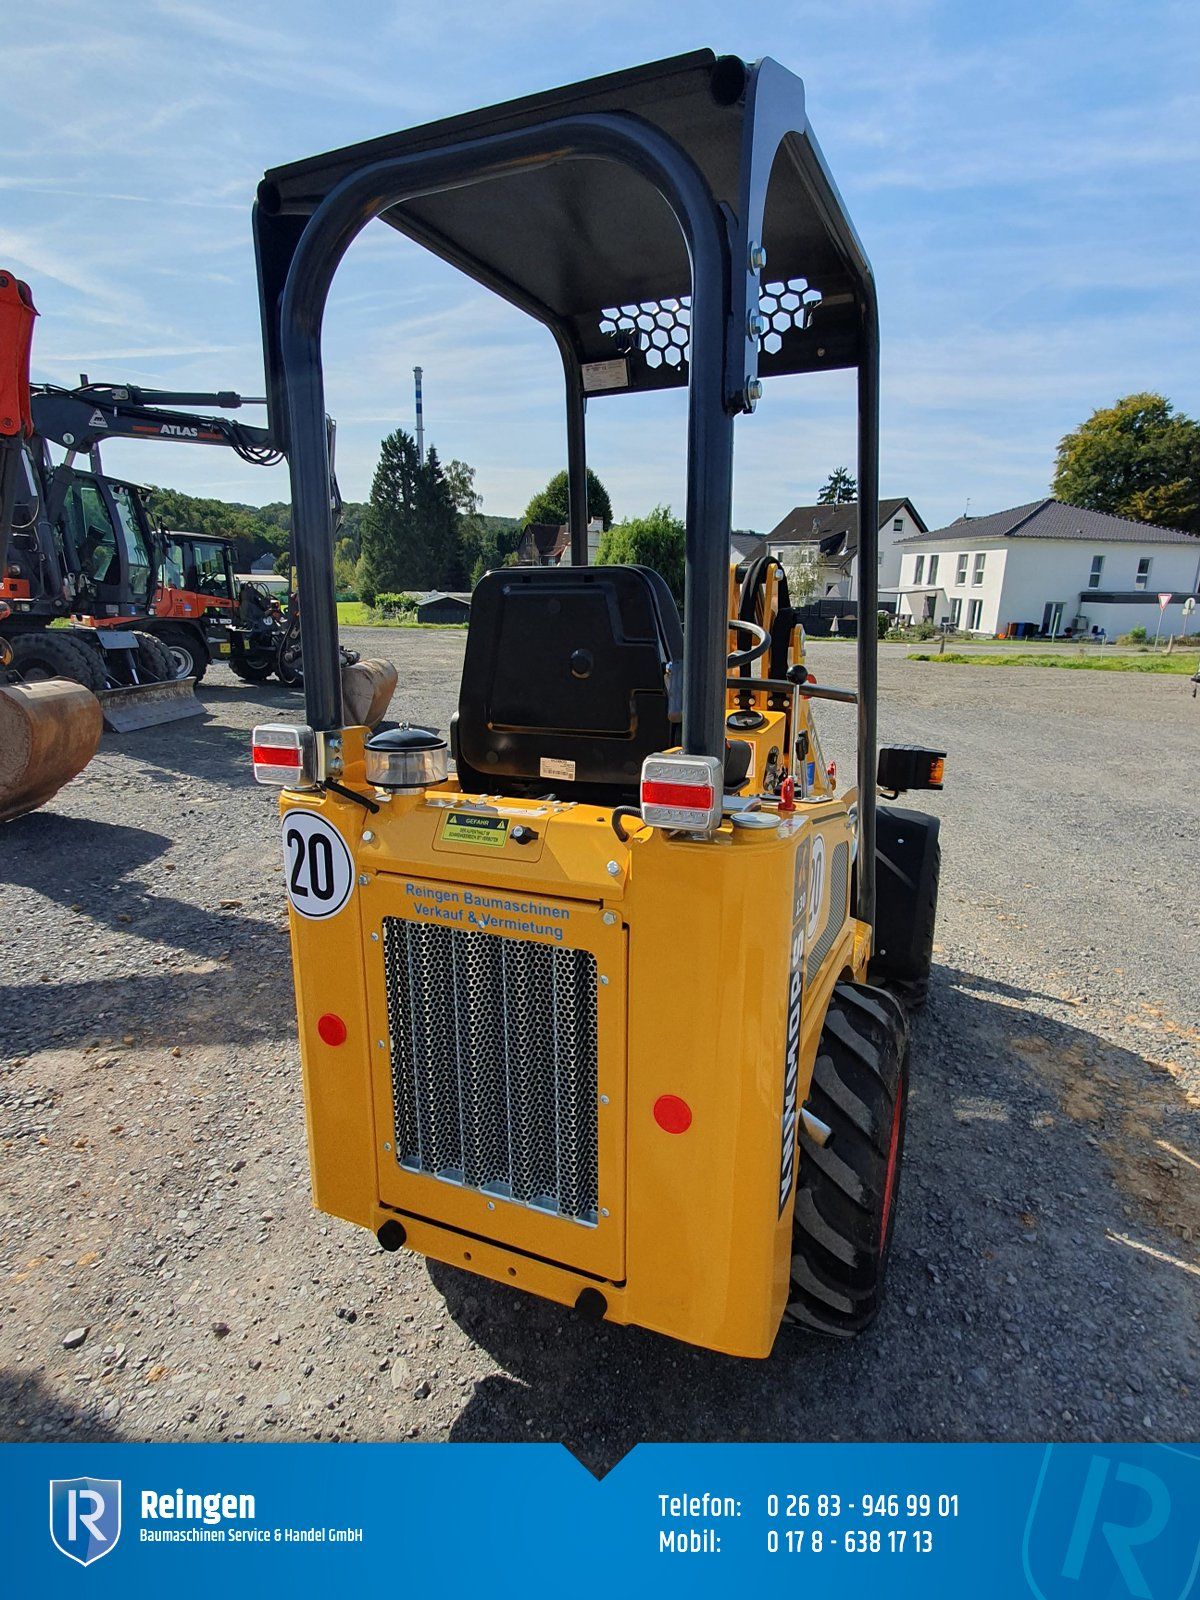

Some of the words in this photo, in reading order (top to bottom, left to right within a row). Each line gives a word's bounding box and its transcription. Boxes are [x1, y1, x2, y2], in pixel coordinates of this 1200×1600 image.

[160, 424, 198, 437] ATLAS
[465, 818, 489, 826] GEFAHR
[287, 828, 335, 901] 20
[406, 883, 459, 903] Reingen
[464, 892, 570, 920] Baumaschinen
[413, 902, 463, 921] Verkauf
[468, 911, 477, 923] &
[481, 912, 563, 941] Vermietung
